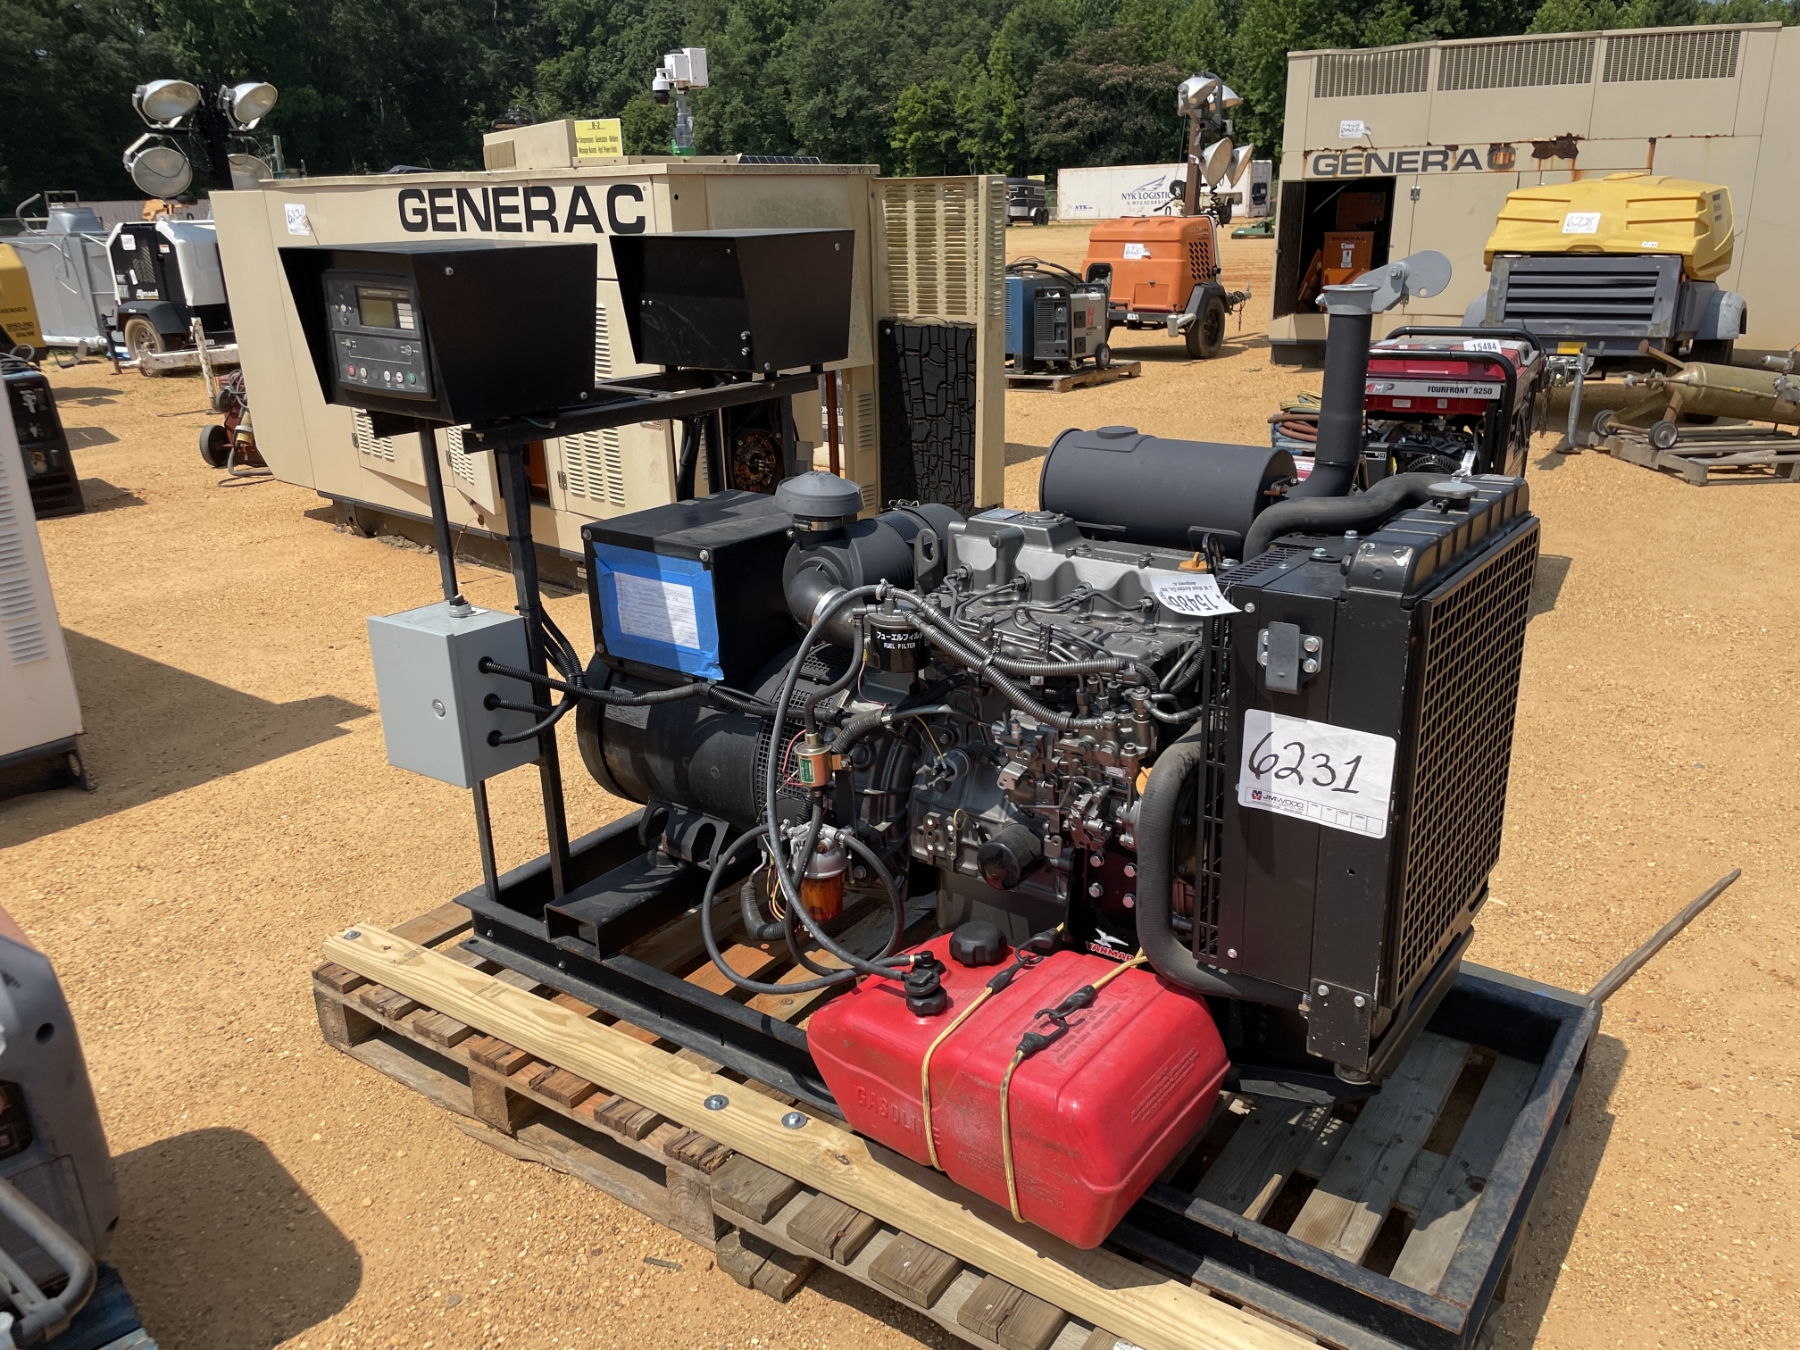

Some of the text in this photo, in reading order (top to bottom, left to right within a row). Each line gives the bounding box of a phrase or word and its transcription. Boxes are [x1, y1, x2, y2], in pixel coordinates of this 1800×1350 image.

[1312, 147, 1516, 176] GENERAC
[1121, 192, 1137, 200] NYK
[398, 183, 647, 235] GENERAC
[1473, 342, 1497, 351] 15484
[1427, 385, 1469, 394] FOURFRONT
[1473, 387, 1493, 395] 9250
[1168, 594, 1219, 612] 15486
[1248, 731, 1363, 794] 6231
[1085, 941, 1135, 962] YANMAR
